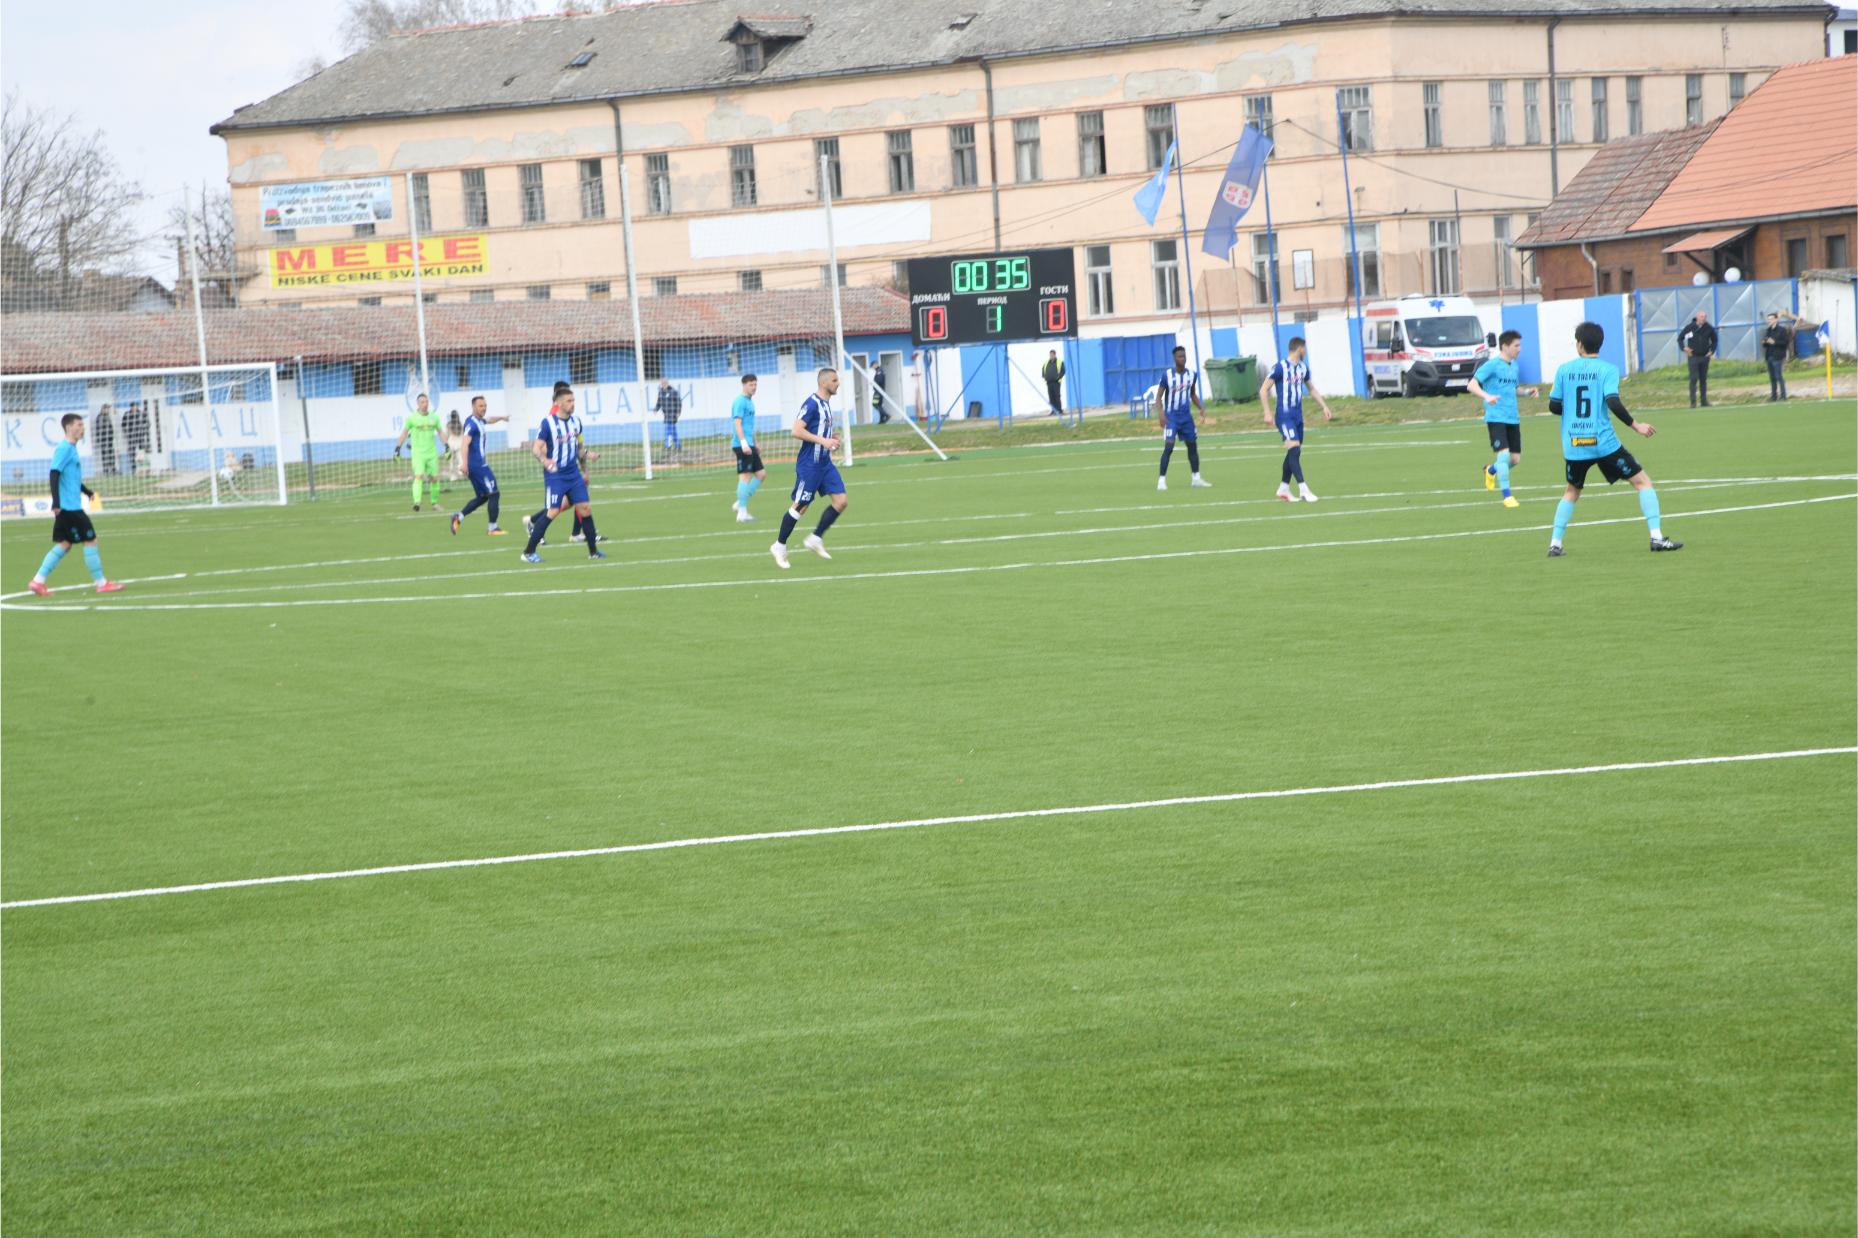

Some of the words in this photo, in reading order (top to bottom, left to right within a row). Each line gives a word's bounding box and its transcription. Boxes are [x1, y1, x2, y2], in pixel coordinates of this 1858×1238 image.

[276, 237, 481, 271] MERE
[278, 274, 330, 286] NISKE
[336, 271, 383, 283] CENE
[389, 267, 442, 280] SVAKI
[448, 263, 483, 274] DAN
[955, 261, 987, 292] 00
[995, 258, 1028, 290] 35
[977, 296, 1008, 306] ПЕРИОД
[1040, 285, 1069, 295] ГОСТИ
[928, 307, 945, 338] 0
[996, 305, 1002, 333] 1
[1048, 300, 1065, 330] 0
[1576, 385, 1591, 419] 6
